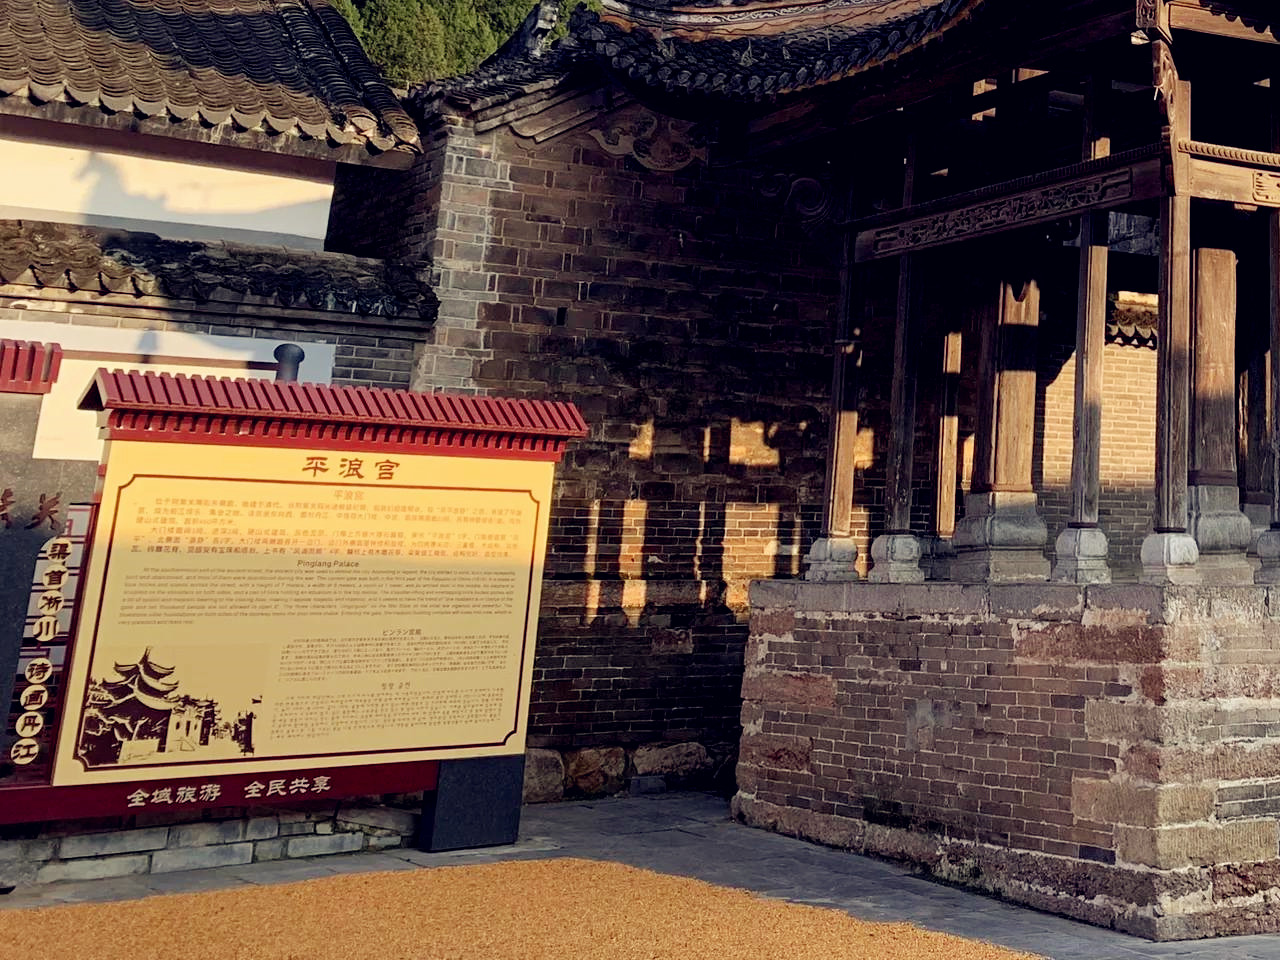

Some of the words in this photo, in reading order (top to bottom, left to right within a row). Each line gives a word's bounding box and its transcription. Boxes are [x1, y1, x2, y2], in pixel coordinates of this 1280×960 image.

[302, 456, 400, 480] 平浪宫
[296, 559, 332, 568] Pinglang
[333, 559, 360, 568] Palace
[33, 542, 72, 638] 渠首淅川
[12, 662, 51, 760] 诗画丹江
[126, 784, 222, 808] 全域旅游
[244, 775, 332, 799] 全民共享
